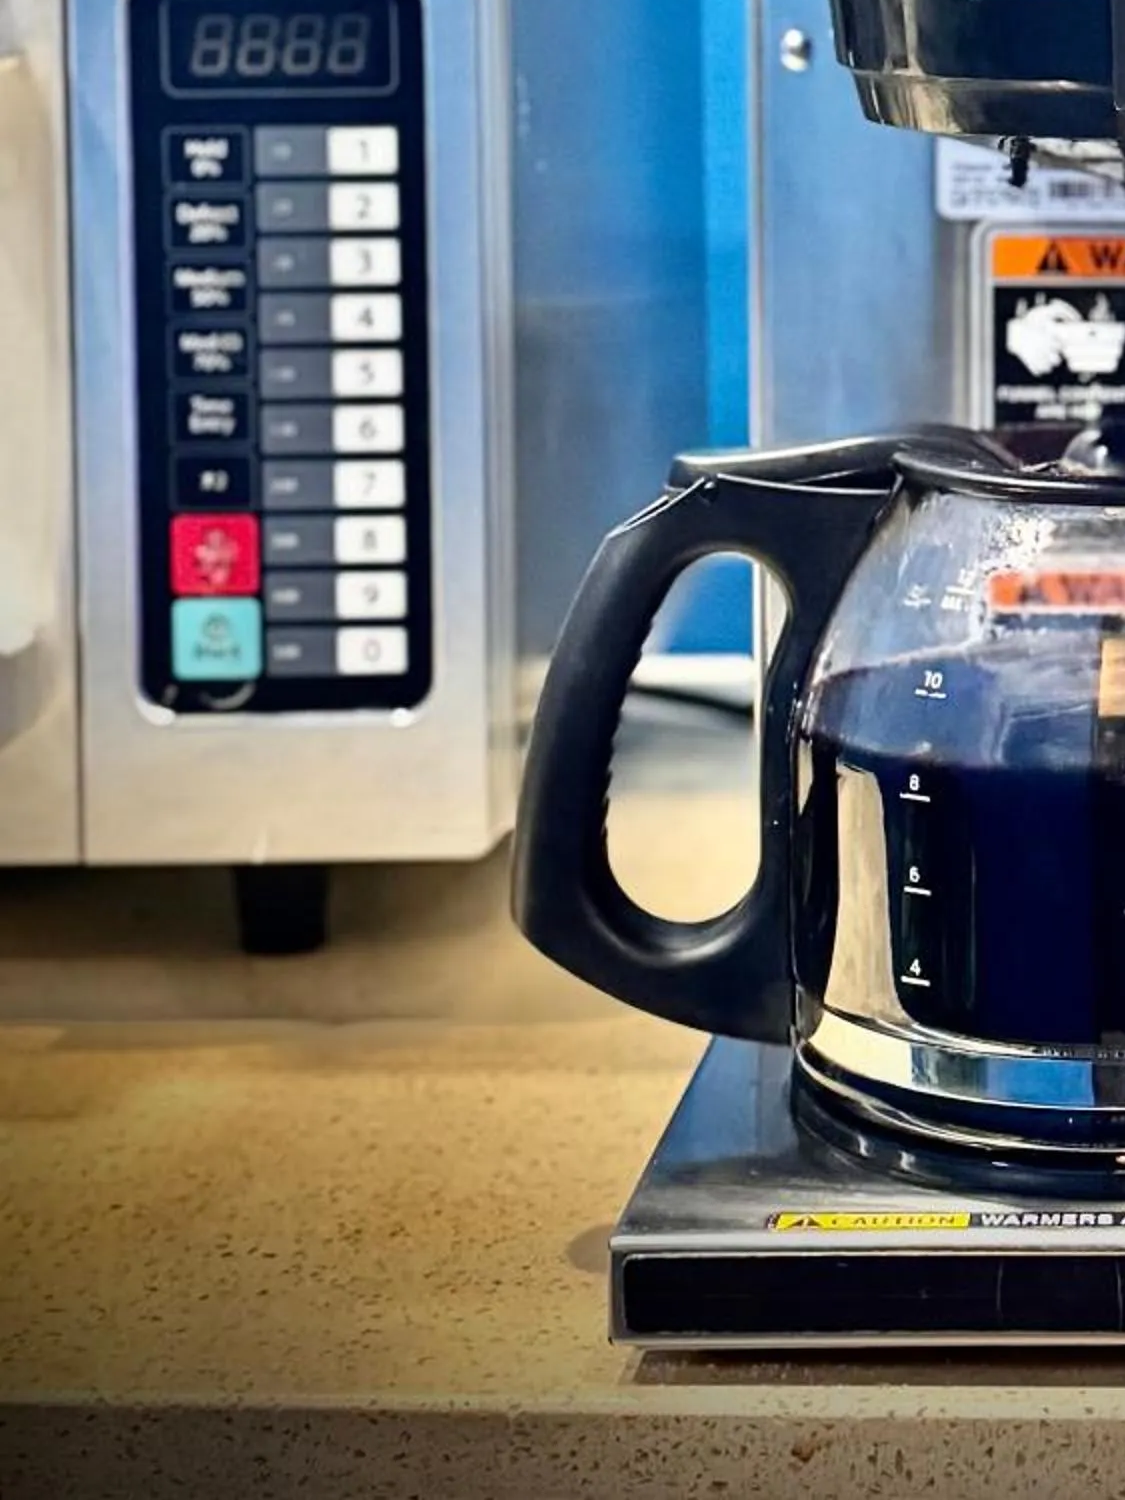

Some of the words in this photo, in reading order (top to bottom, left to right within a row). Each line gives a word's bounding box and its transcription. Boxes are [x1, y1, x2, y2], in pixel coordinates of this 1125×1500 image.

[924, 670, 943, 689] 10
[909, 774, 920, 791] 8
[909, 866, 920, 883] 6
[909, 959, 921, 976] 4
[981, 1213, 1114, 1226] WARMERS
